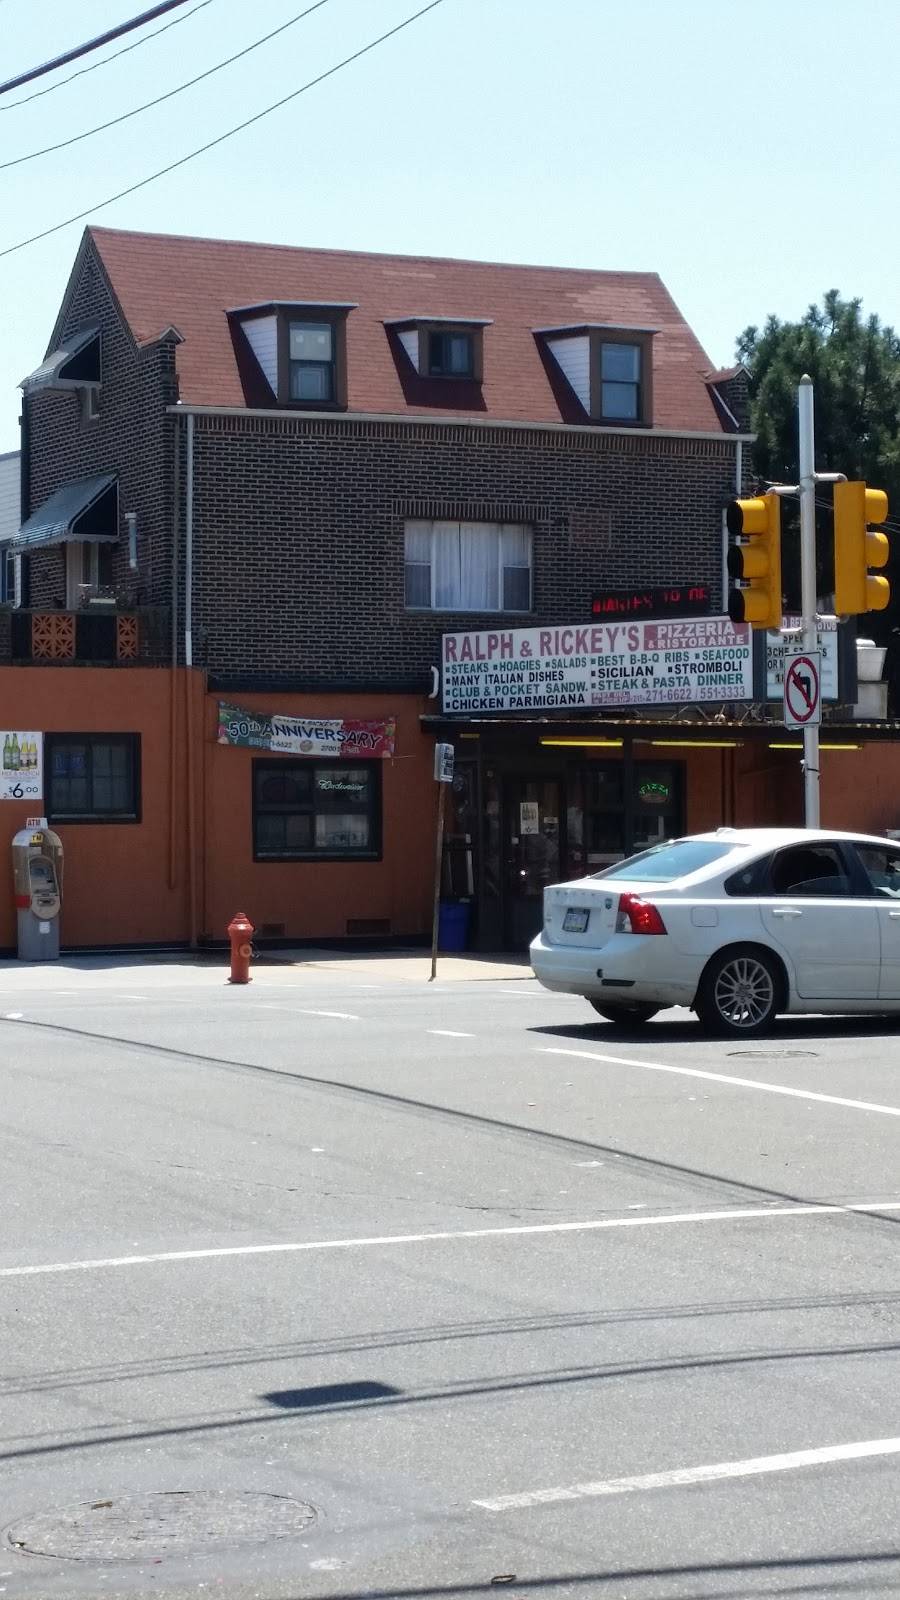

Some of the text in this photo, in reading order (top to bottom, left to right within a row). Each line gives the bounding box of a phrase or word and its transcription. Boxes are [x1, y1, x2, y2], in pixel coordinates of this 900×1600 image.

[657, 622, 735, 638] PIZZERIA
[657, 634, 745, 649] RISTORANTE
[445, 624, 640, 662] RALPH & RICKEY'S
[451, 648, 750, 674] STEAKS HOAGIES SALADS BEST B-B-Q RIBS SEAFOOD
[451, 661, 742, 686] MANY ITALIAN DISHES SICILIAN STROMBOLI
[451, 674, 743, 698] CLUB & POCKET SANDW. STEAK & PASTA DINNER
[646, 689, 692, 702] 271-6622
[700, 686, 746, 699] 551-3333
[452, 699, 504, 710] CHICKEN
[509, 693, 585, 707] PARMIGIANA
[261, 723, 382, 749] ANNIVERSARY
